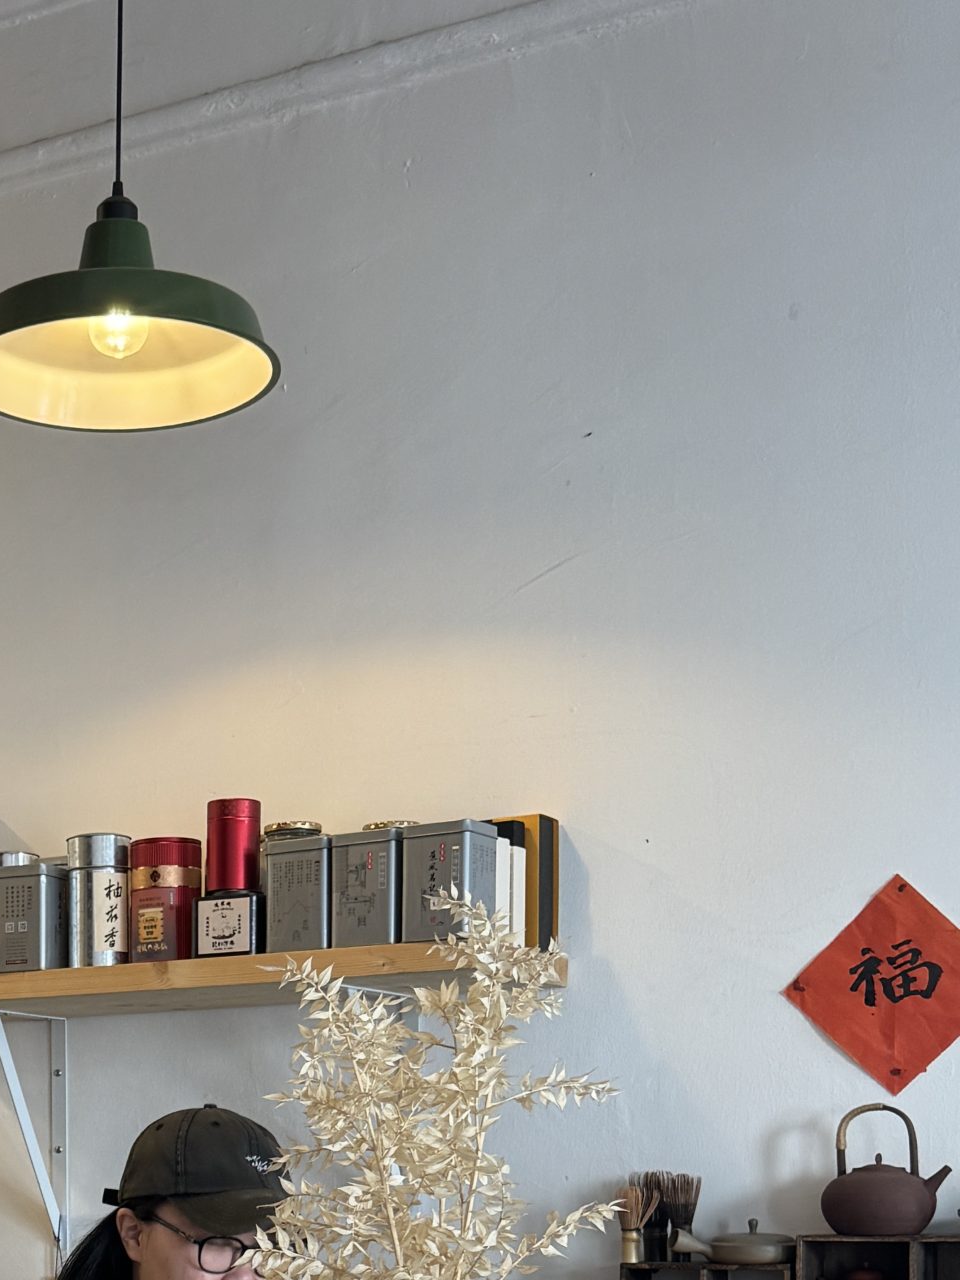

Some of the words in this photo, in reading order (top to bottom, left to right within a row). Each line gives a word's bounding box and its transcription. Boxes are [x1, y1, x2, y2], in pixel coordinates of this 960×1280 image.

[104, 879, 123, 948] 柚花香
[849, 939, 944, 1007] 福
